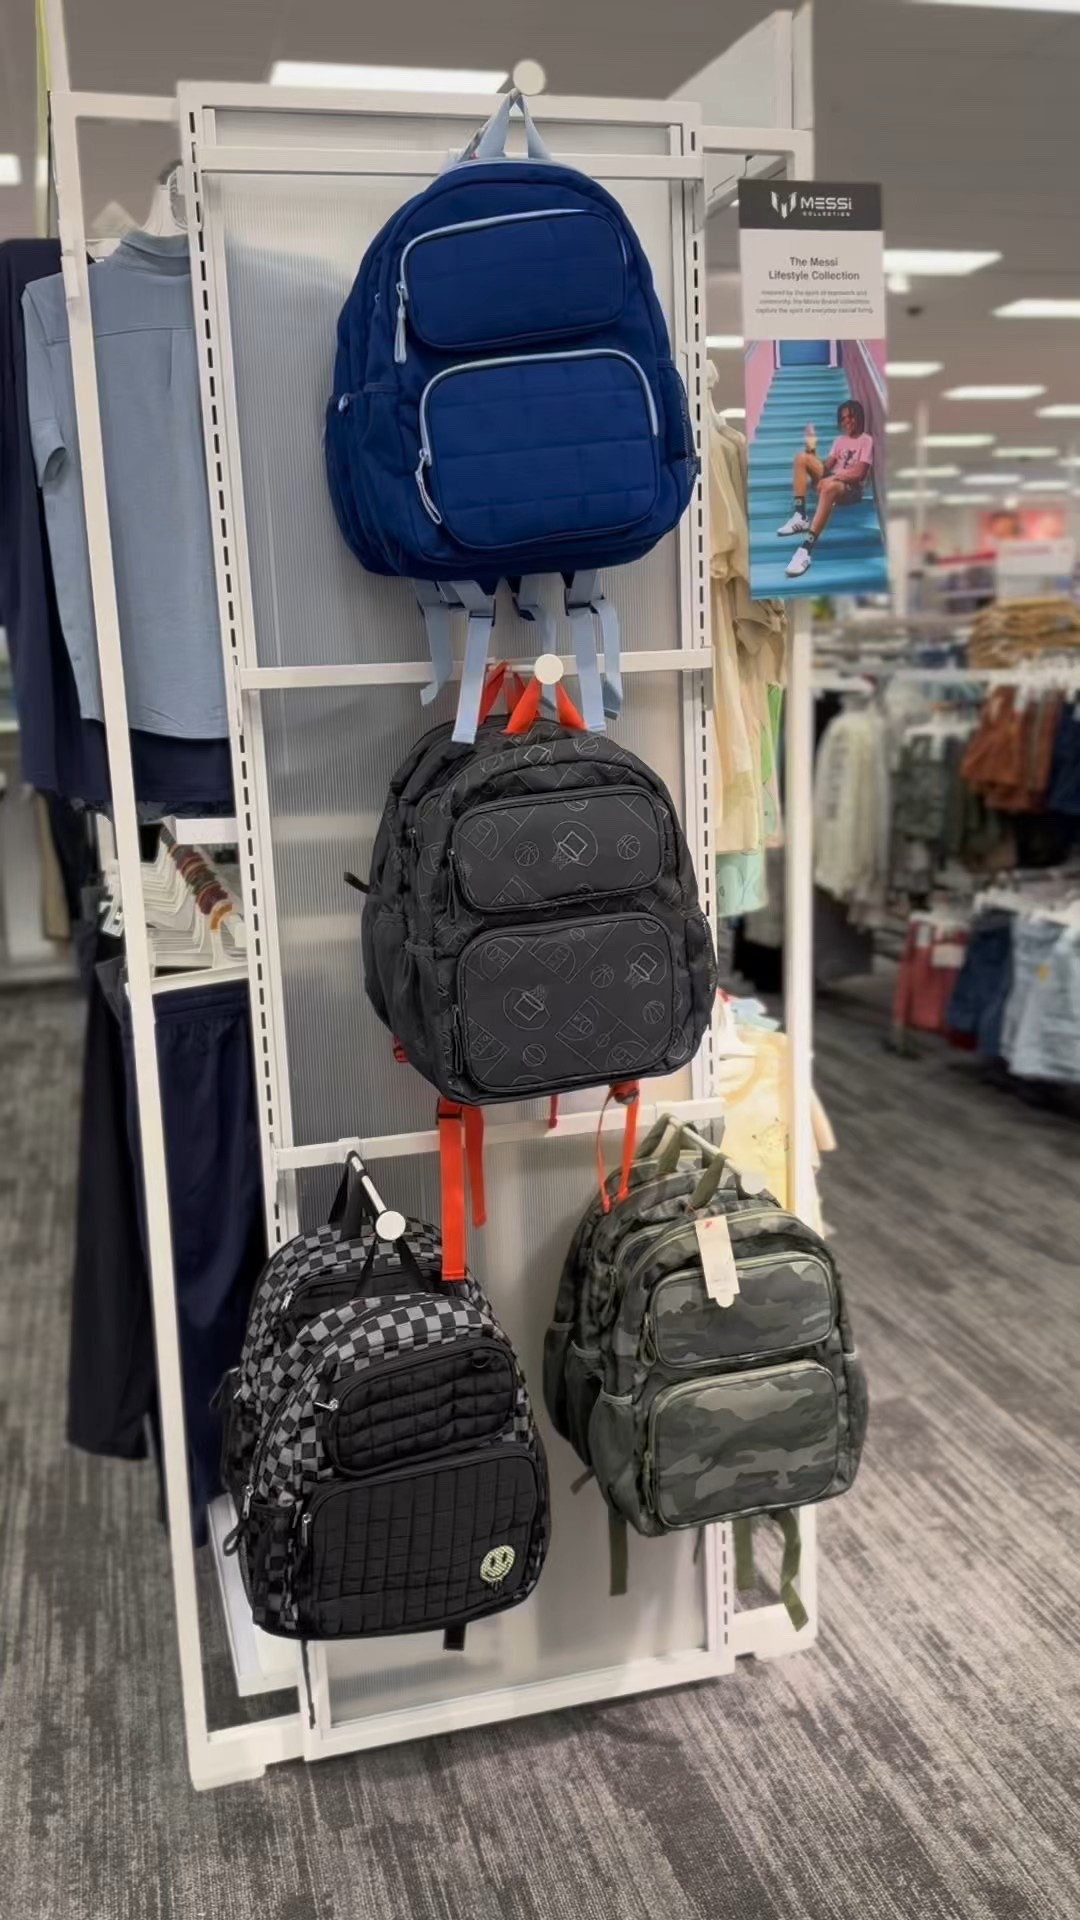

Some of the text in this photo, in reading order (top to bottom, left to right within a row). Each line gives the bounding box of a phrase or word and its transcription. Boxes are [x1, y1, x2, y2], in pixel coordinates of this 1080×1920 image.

[789, 257, 838, 267] The Messi
[768, 270, 860, 281] Lifestyle Collection
